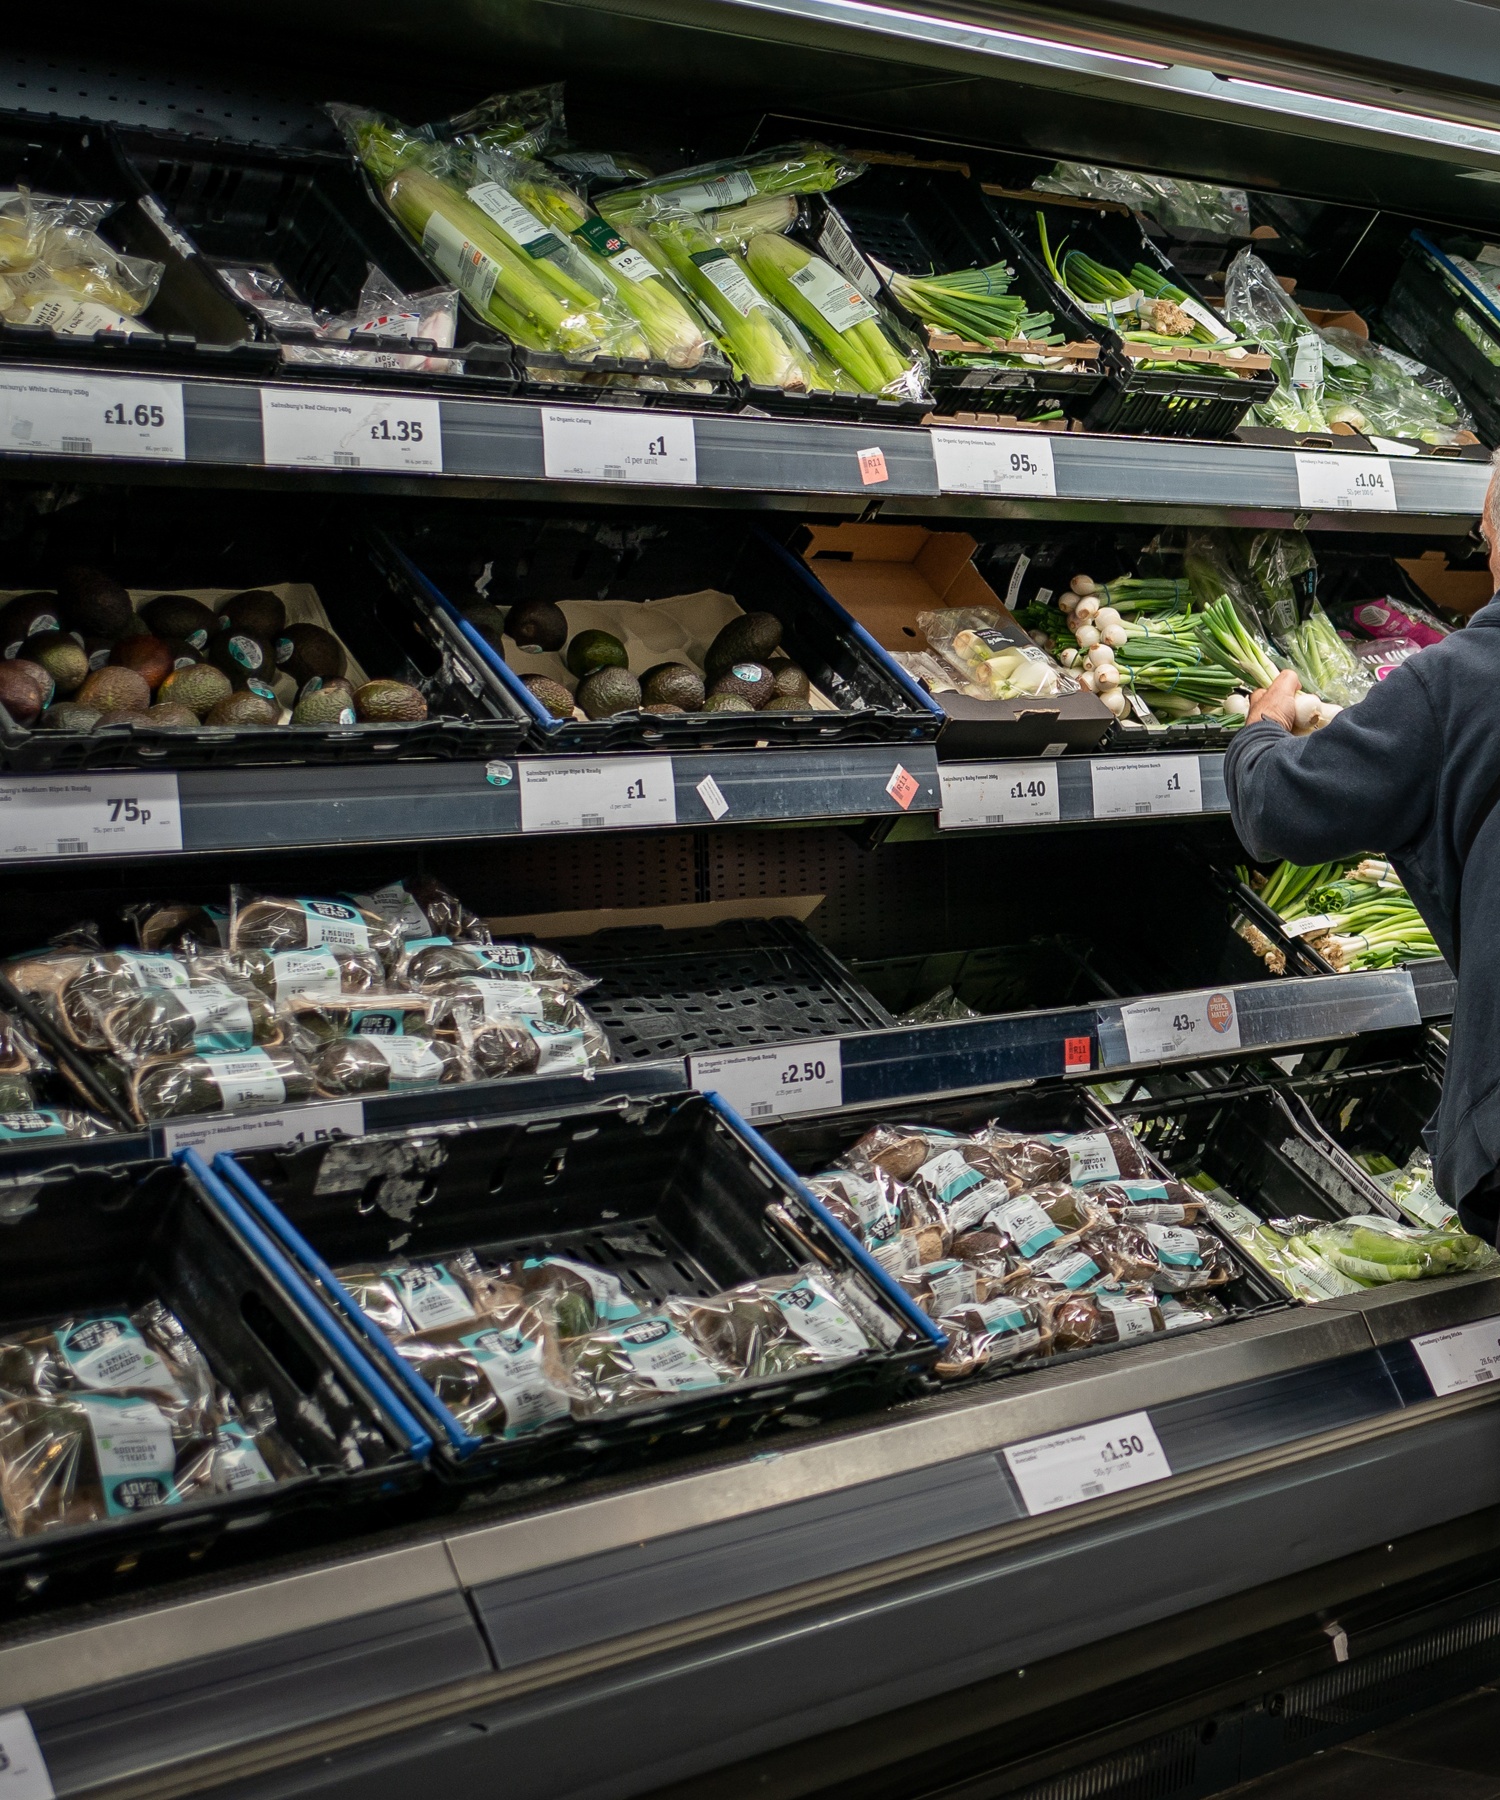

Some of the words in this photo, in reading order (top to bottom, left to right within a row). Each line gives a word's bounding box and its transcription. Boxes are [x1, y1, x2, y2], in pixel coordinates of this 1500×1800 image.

[618, 257, 633, 268] 19
[33, 302, 53, 325] WHITE
[49, 387, 73, 396] Chicory
[74, 389, 89, 397] 250g
[271, 402, 304, 411] Sainsbury's
[317, 404, 338, 413] Chicory
[105, 403, 165, 428] £1.65
[371, 419, 423, 442] £1.35
[649, 436, 667, 456] £1
[632, 457, 643, 465] per
[644, 457, 658, 465] unit
[868, 458, 881, 468] R11
[1010, 454, 1037, 475] 95p
[1355, 473, 1384, 487] £1.04
[943, 775, 964, 783] Sainsbury's
[1167, 773, 1181, 790] £1
[71, 785, 91, 793] Ready
[627, 779, 646, 799] £1
[1010, 781, 1046, 799] £1.40
[107, 798, 151, 824] 75p
[318, 907, 350, 919] READY
[321, 936, 356, 945] AVOCADOS
[328, 930, 355, 938] MEDIUM
[1209, 1002, 1229, 1012] PRICE
[1211, 1010, 1229, 1019] MATCH
[361, 1017, 383, 1028] RIPE
[384, 1018, 391, 1026] &
[1173, 1014, 1195, 1032] 43p
[1073, 1045, 1086, 1055] R11
[781, 1061, 826, 1084] £2.50
[174, 1130, 211, 1139] Sainsbury's
[217, 1125, 241, 1134] Medium
[242, 1123, 257, 1132] Ripe
[264, 1119, 284, 1129] Ready
[175, 1138, 205, 1146] Avocados
[1380, 1175, 1395, 1184] CELERY
[1419, 1177, 1434, 1196] CELER
[73, 1323, 101, 1341] RIPE
[78, 1327, 121, 1350] READY
[1418, 1337, 1440, 1347] Sainsbury's
[1439, 1333, 1452, 1343] Celery
[1451, 1331, 1463, 1339] Sticks
[105, 1350, 133, 1365] SMALL
[98, 1354, 141, 1378] AVOCADOS
[1101, 1435, 1144, 1463] £1.50
